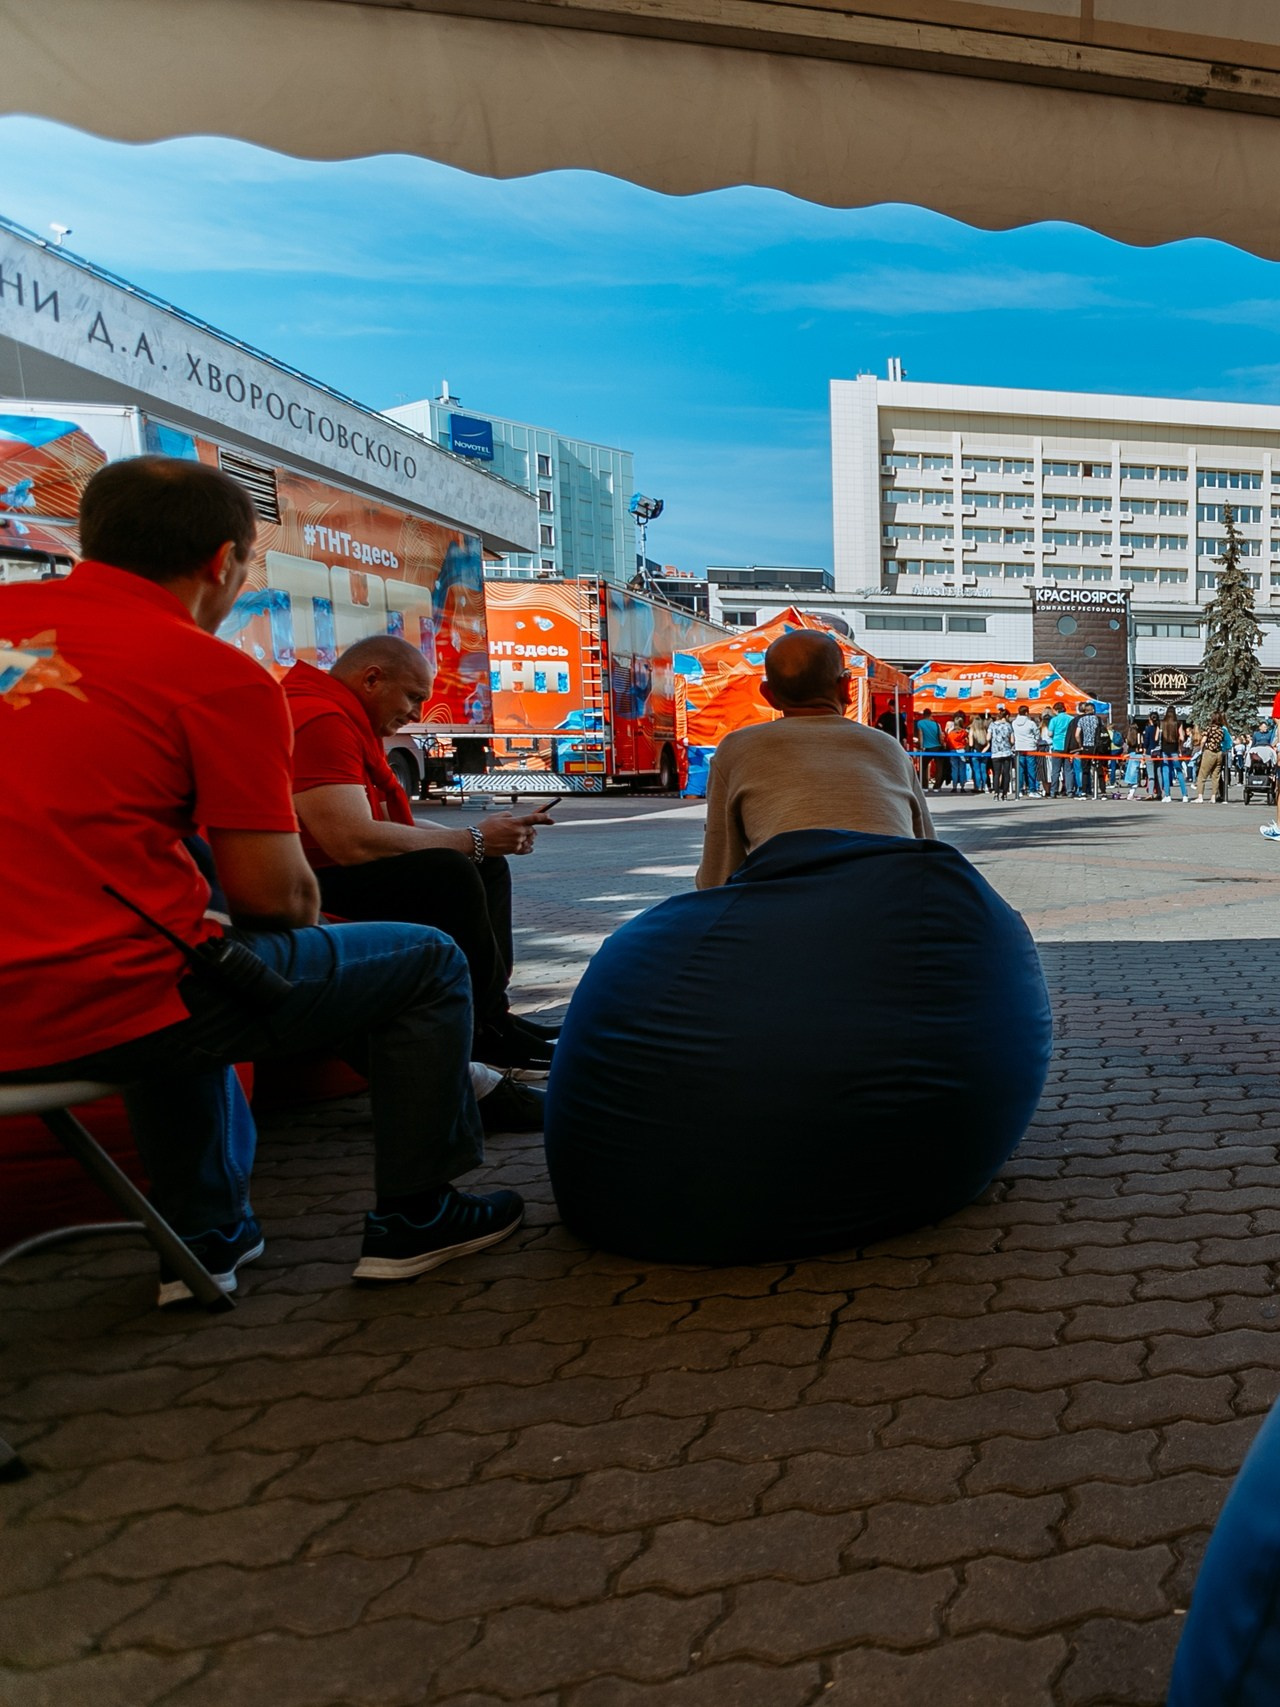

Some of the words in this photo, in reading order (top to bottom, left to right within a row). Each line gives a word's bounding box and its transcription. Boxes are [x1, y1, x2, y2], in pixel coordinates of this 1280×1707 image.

[186, 352, 417, 479] ХВОРОСТОВСКОГО
[454, 439, 491, 454] NOVOTEL
[304, 524, 399, 569] #ТНТздесь
[1035, 589, 1126, 605] КРАСНОЯРСК
[1077, 606, 1126, 614] РЕСТОРАНОВ
[959, 671, 1019, 680] #ТНТздесь
[1149, 673, 1188, 689] ФИРМА
